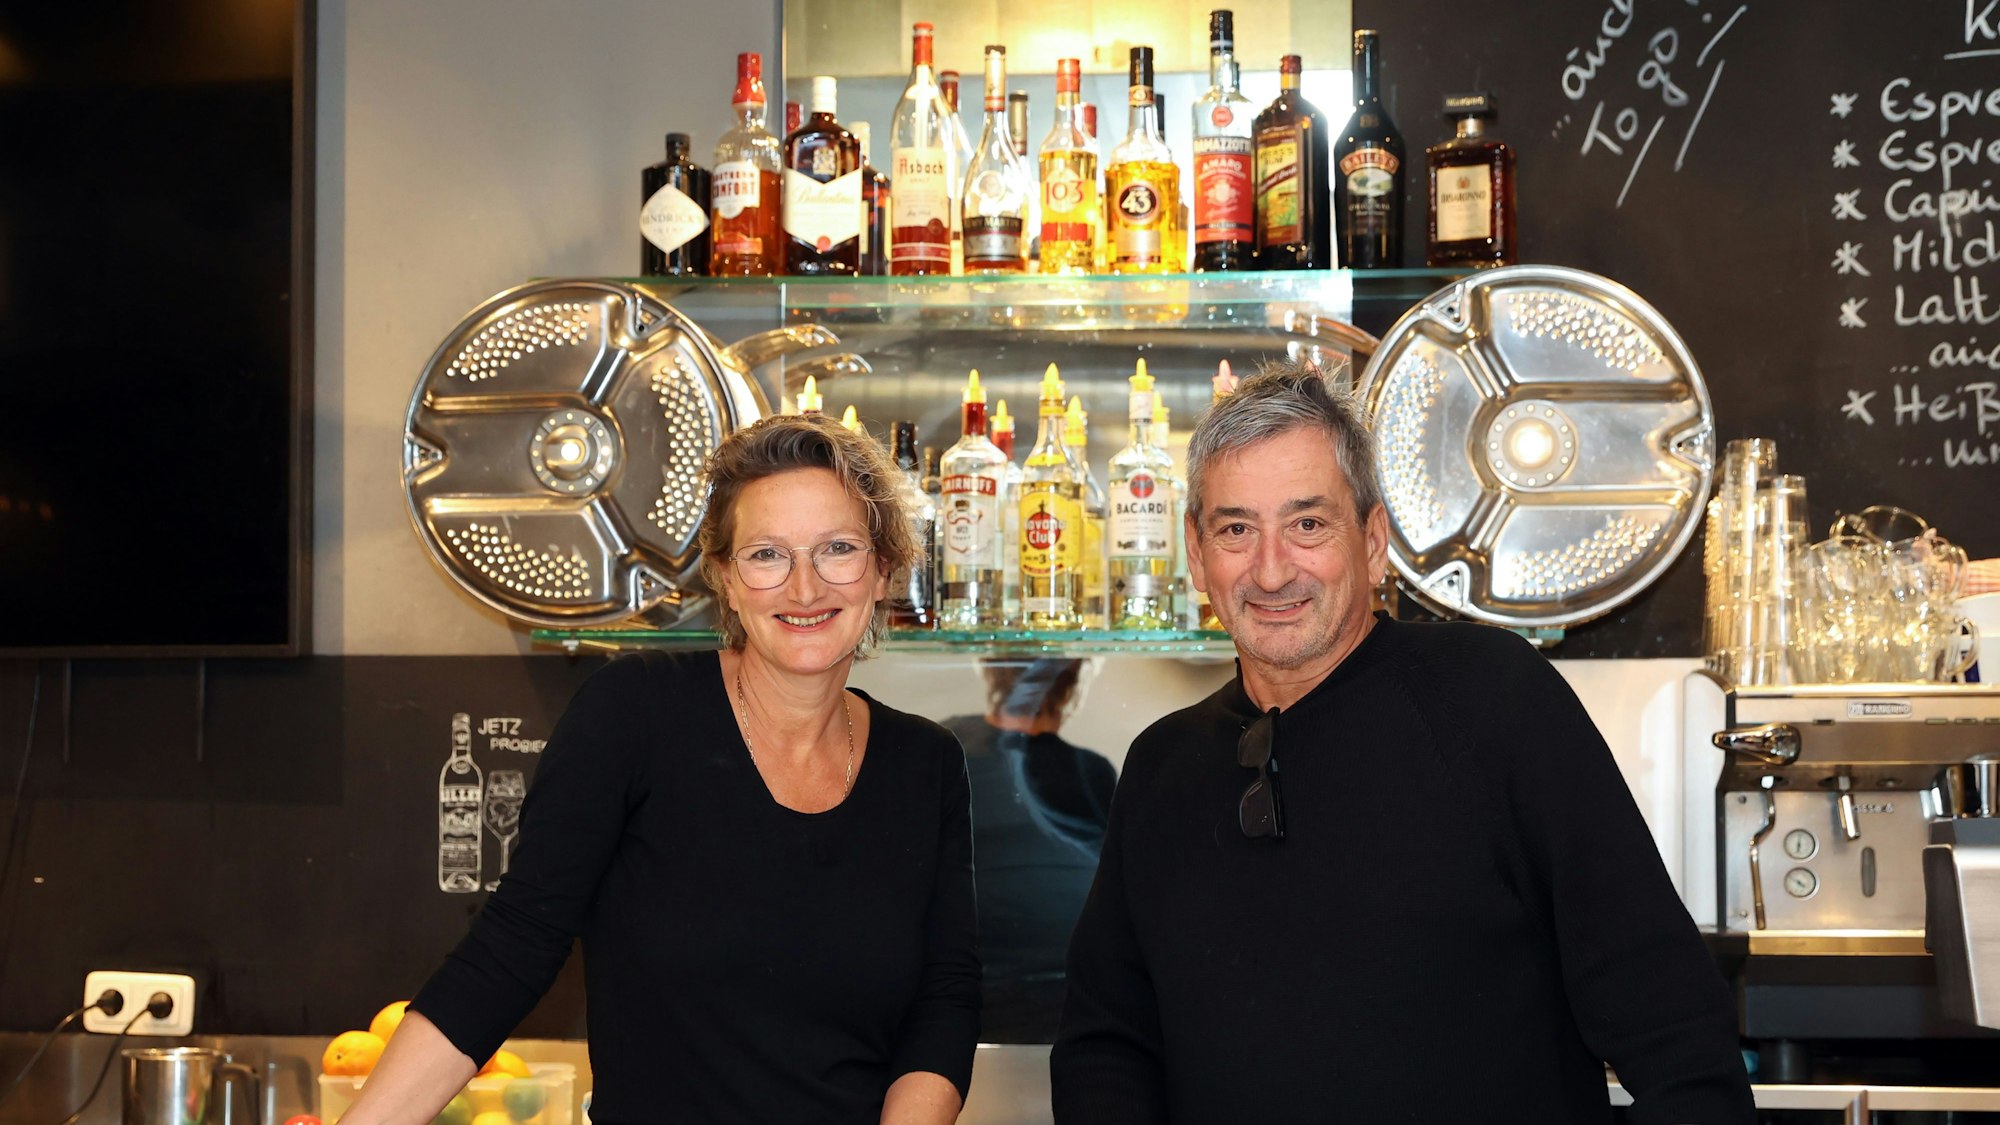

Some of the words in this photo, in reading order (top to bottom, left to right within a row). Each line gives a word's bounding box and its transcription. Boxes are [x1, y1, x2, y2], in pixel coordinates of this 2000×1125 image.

[1965, 0, 2000, 44] K
[1581, 100, 1639, 156] To
[898, 158, 944, 176] Asbach
[1202, 158, 1242, 173] AMARO
[1343, 151, 1396, 171] BAILEYS
[1045, 180, 1084, 205] 103
[1121, 189, 1152, 214] 43
[1029, 530, 1057, 545] Club
[1039, 553, 1047, 565] 3
[477, 717, 523, 736] JETZ
